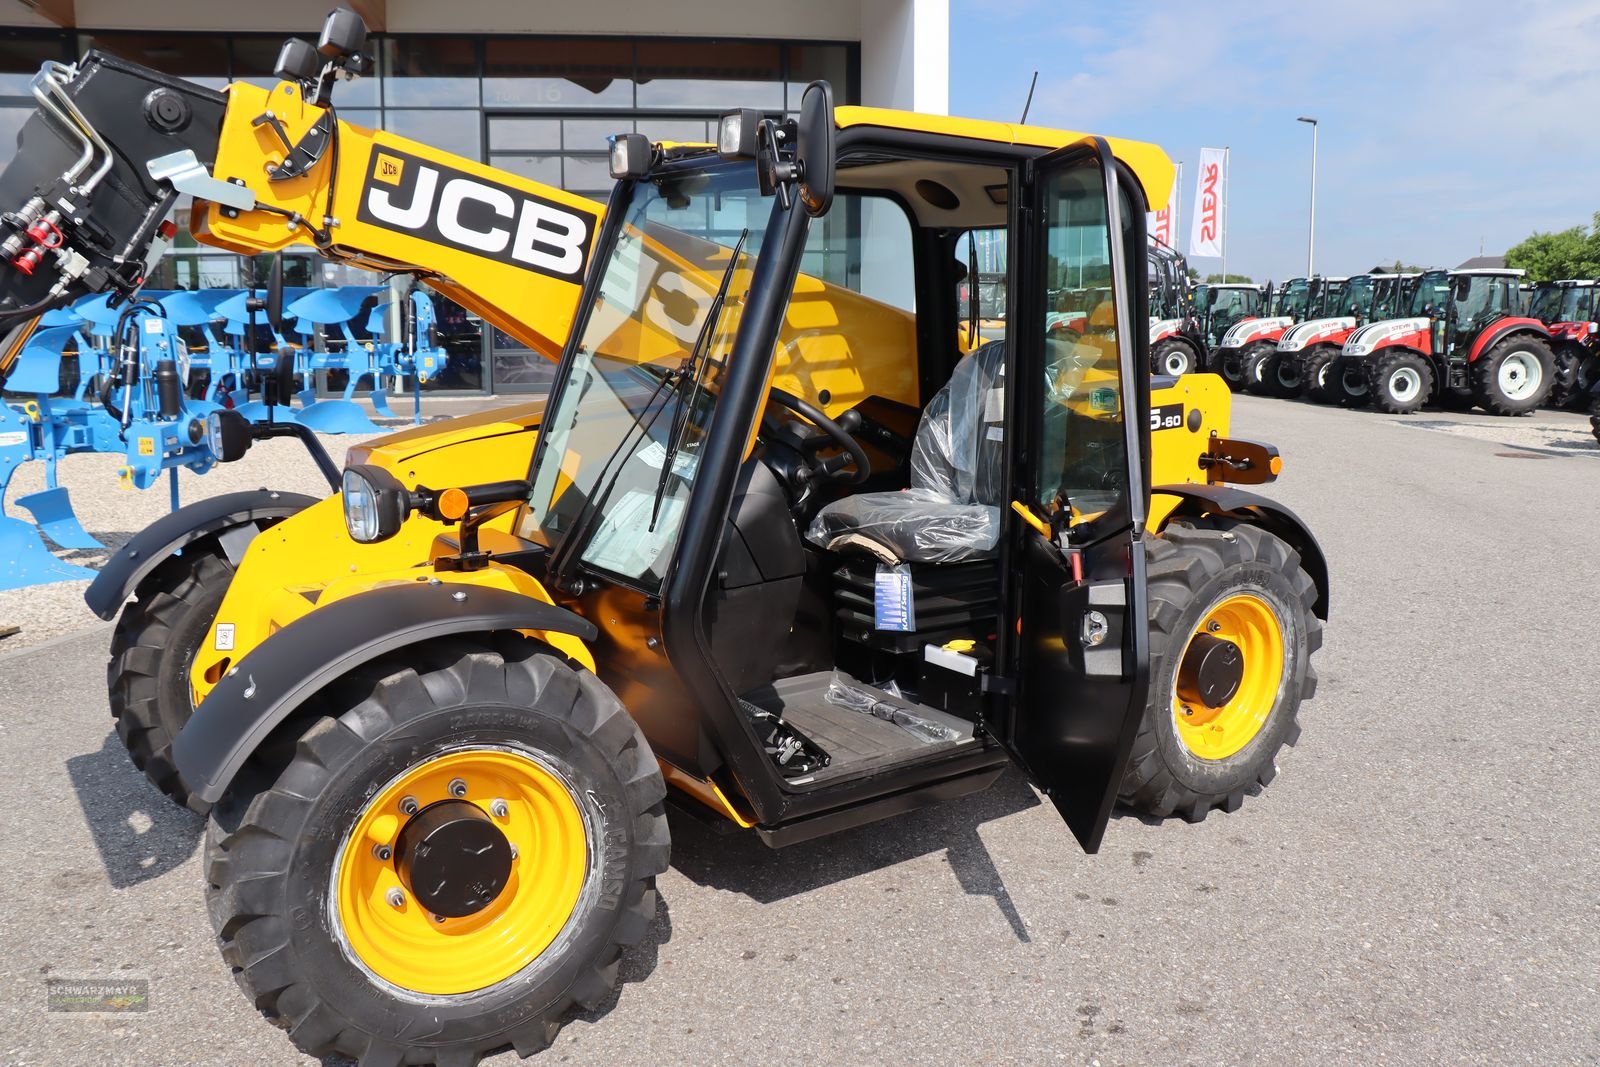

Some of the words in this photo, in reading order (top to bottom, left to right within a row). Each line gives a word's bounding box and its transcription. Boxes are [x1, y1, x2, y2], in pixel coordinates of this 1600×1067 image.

[536, 81, 562, 102] 16
[382, 161, 397, 175] JCB
[367, 165, 587, 275] JCB
[901, 575, 909, 605] Seating
[600, 828, 628, 911] CAMSO
